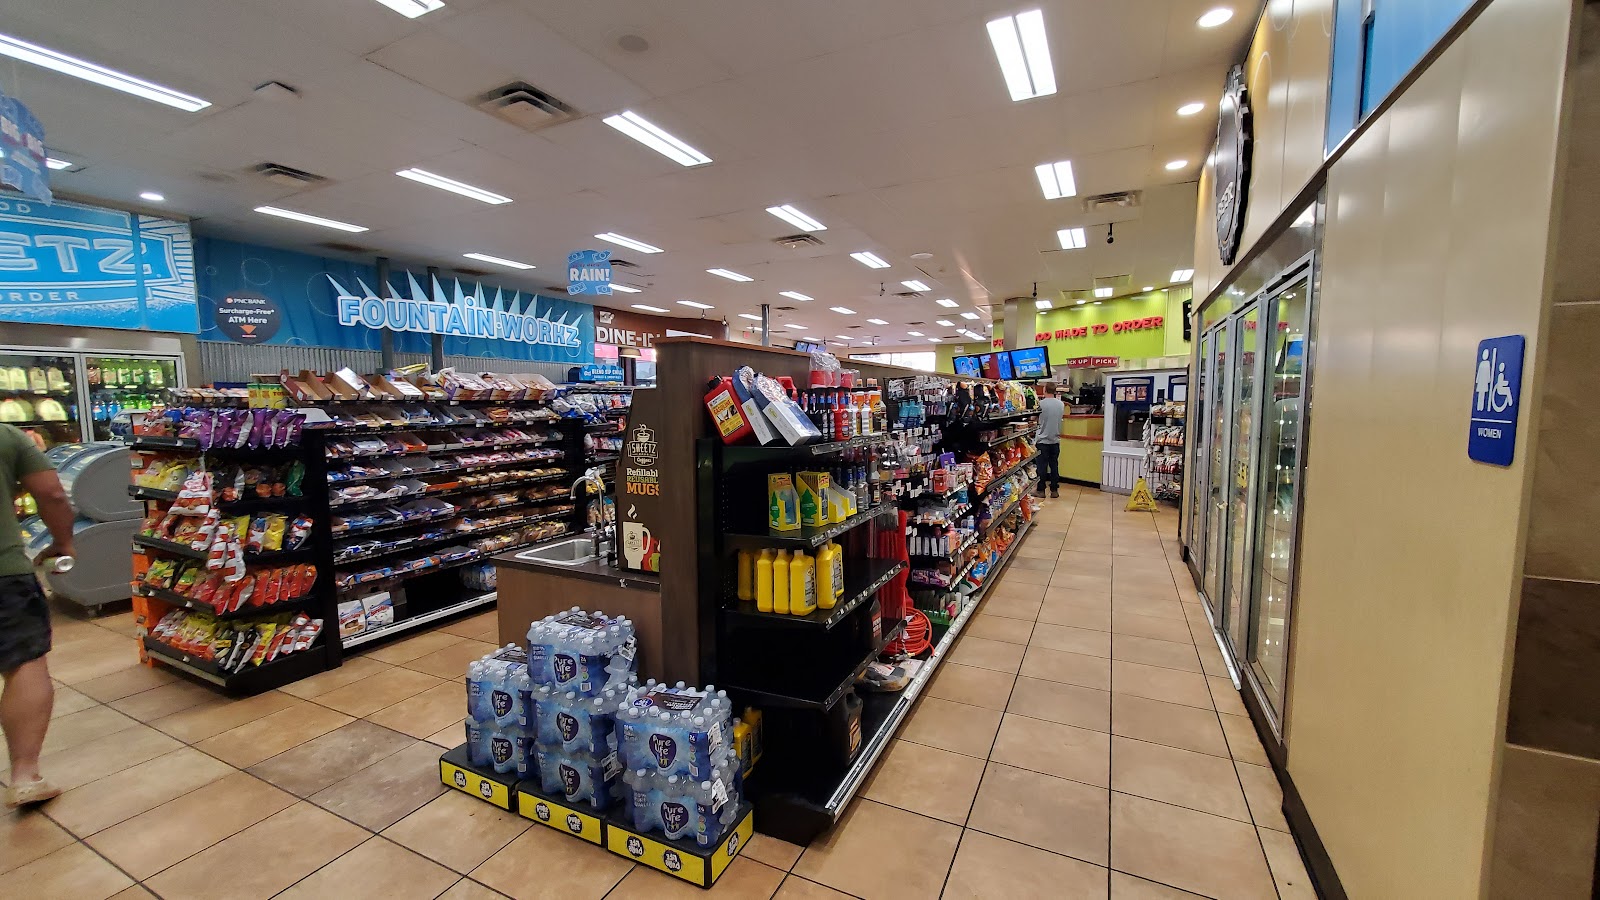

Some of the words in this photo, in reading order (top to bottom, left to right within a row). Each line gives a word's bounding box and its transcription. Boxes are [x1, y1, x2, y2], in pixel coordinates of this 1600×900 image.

[570, 268, 610, 282] RAIN!
[0, 292, 80, 302] RDER
[228, 316, 247, 324] ATM
[247, 316, 268, 324] Here
[1055, 326, 1088, 341] MADE
[1091, 323, 1109, 335] TO
[1112, 316, 1164, 333] ORDER
[1477, 427, 1502, 440] WOMEN
[631, 442, 657, 455] SHEETZ
[554, 663, 572, 675] Life
[652, 734, 672, 748] Pure
[654, 743, 669, 757] Life
[662, 803, 684, 815] Pure
[664, 812, 682, 825] Life
